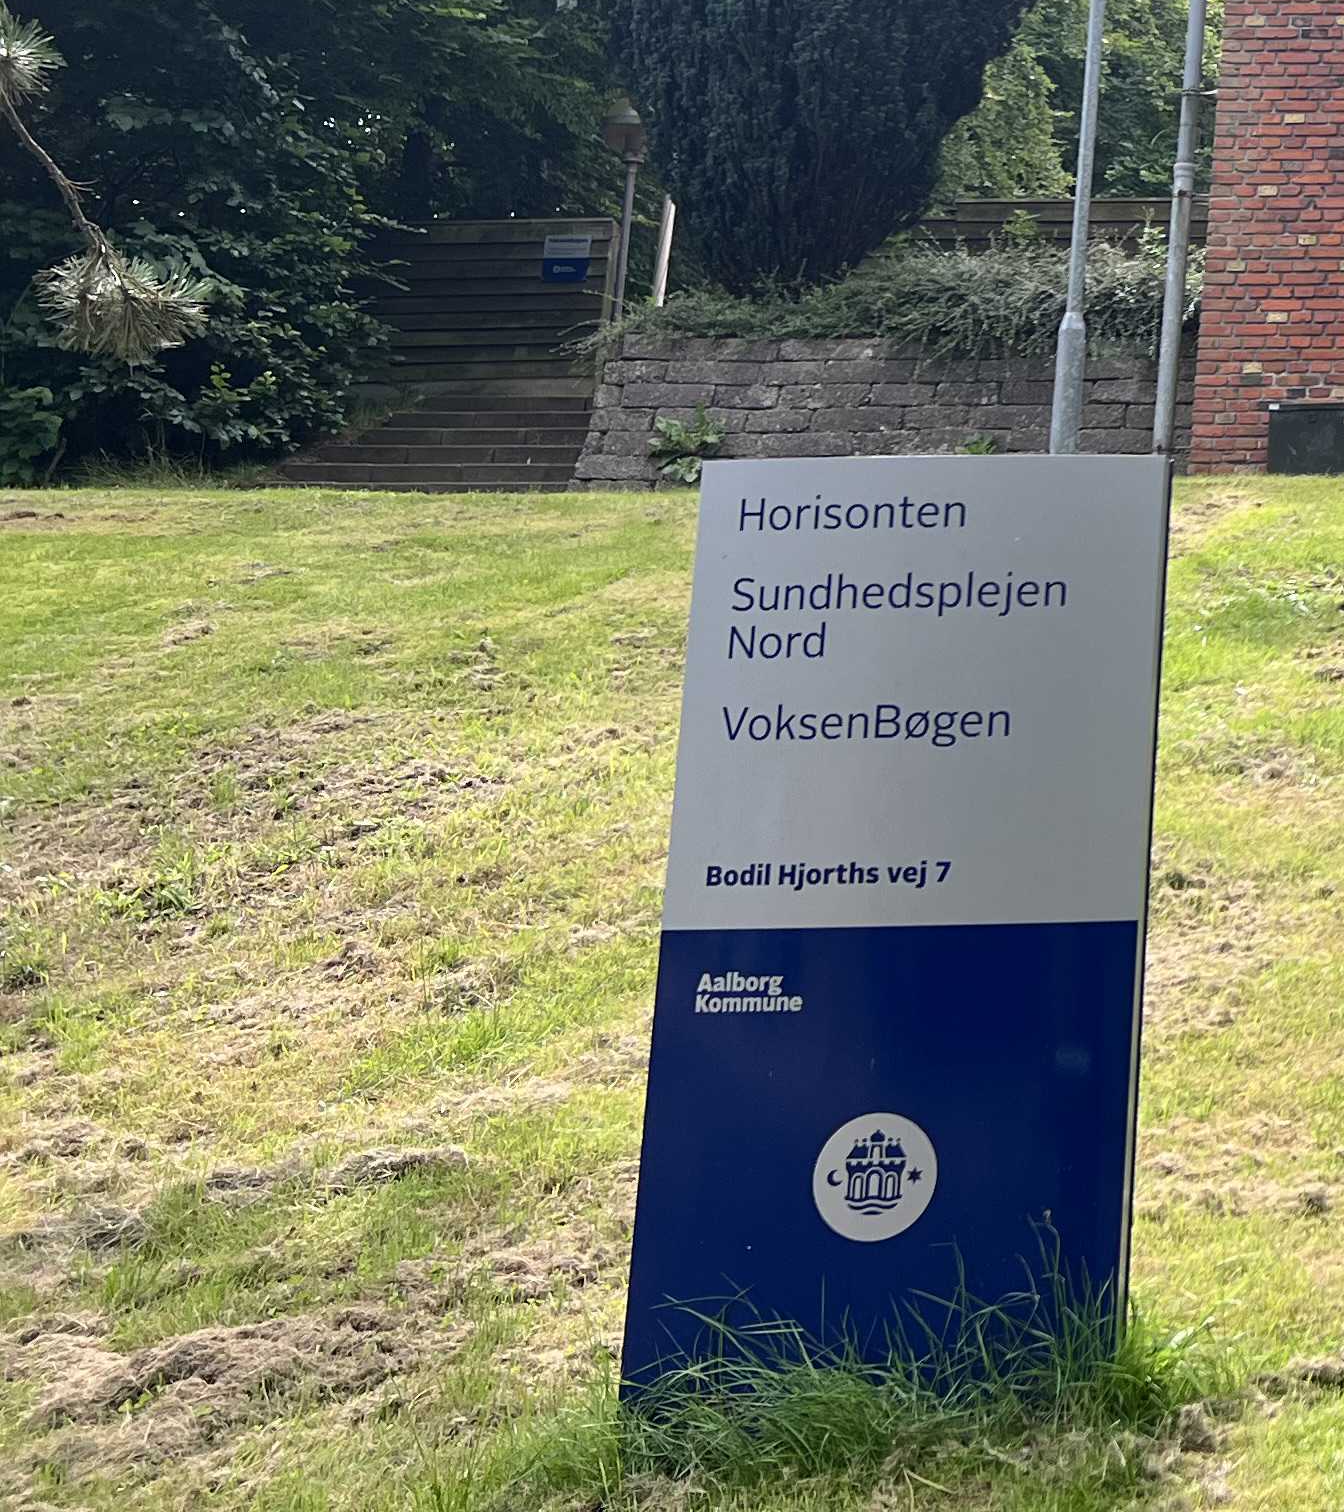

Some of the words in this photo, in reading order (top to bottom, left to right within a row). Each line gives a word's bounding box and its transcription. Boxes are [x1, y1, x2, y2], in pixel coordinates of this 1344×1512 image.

[738, 494, 967, 532] Horisonten
[731, 571, 1068, 617] Sundhedsplejen
[727, 622, 827, 660] Nord
[722, 703, 1012, 748] VoksenBøgen
[705, 863, 772, 887] Bodil
[777, 861, 880, 891] Hjorths
[887, 860, 928, 889] vej
[935, 861, 952, 883] 7
[696, 971, 784, 996] Aalborg
[694, 994, 804, 1014] Kommune
